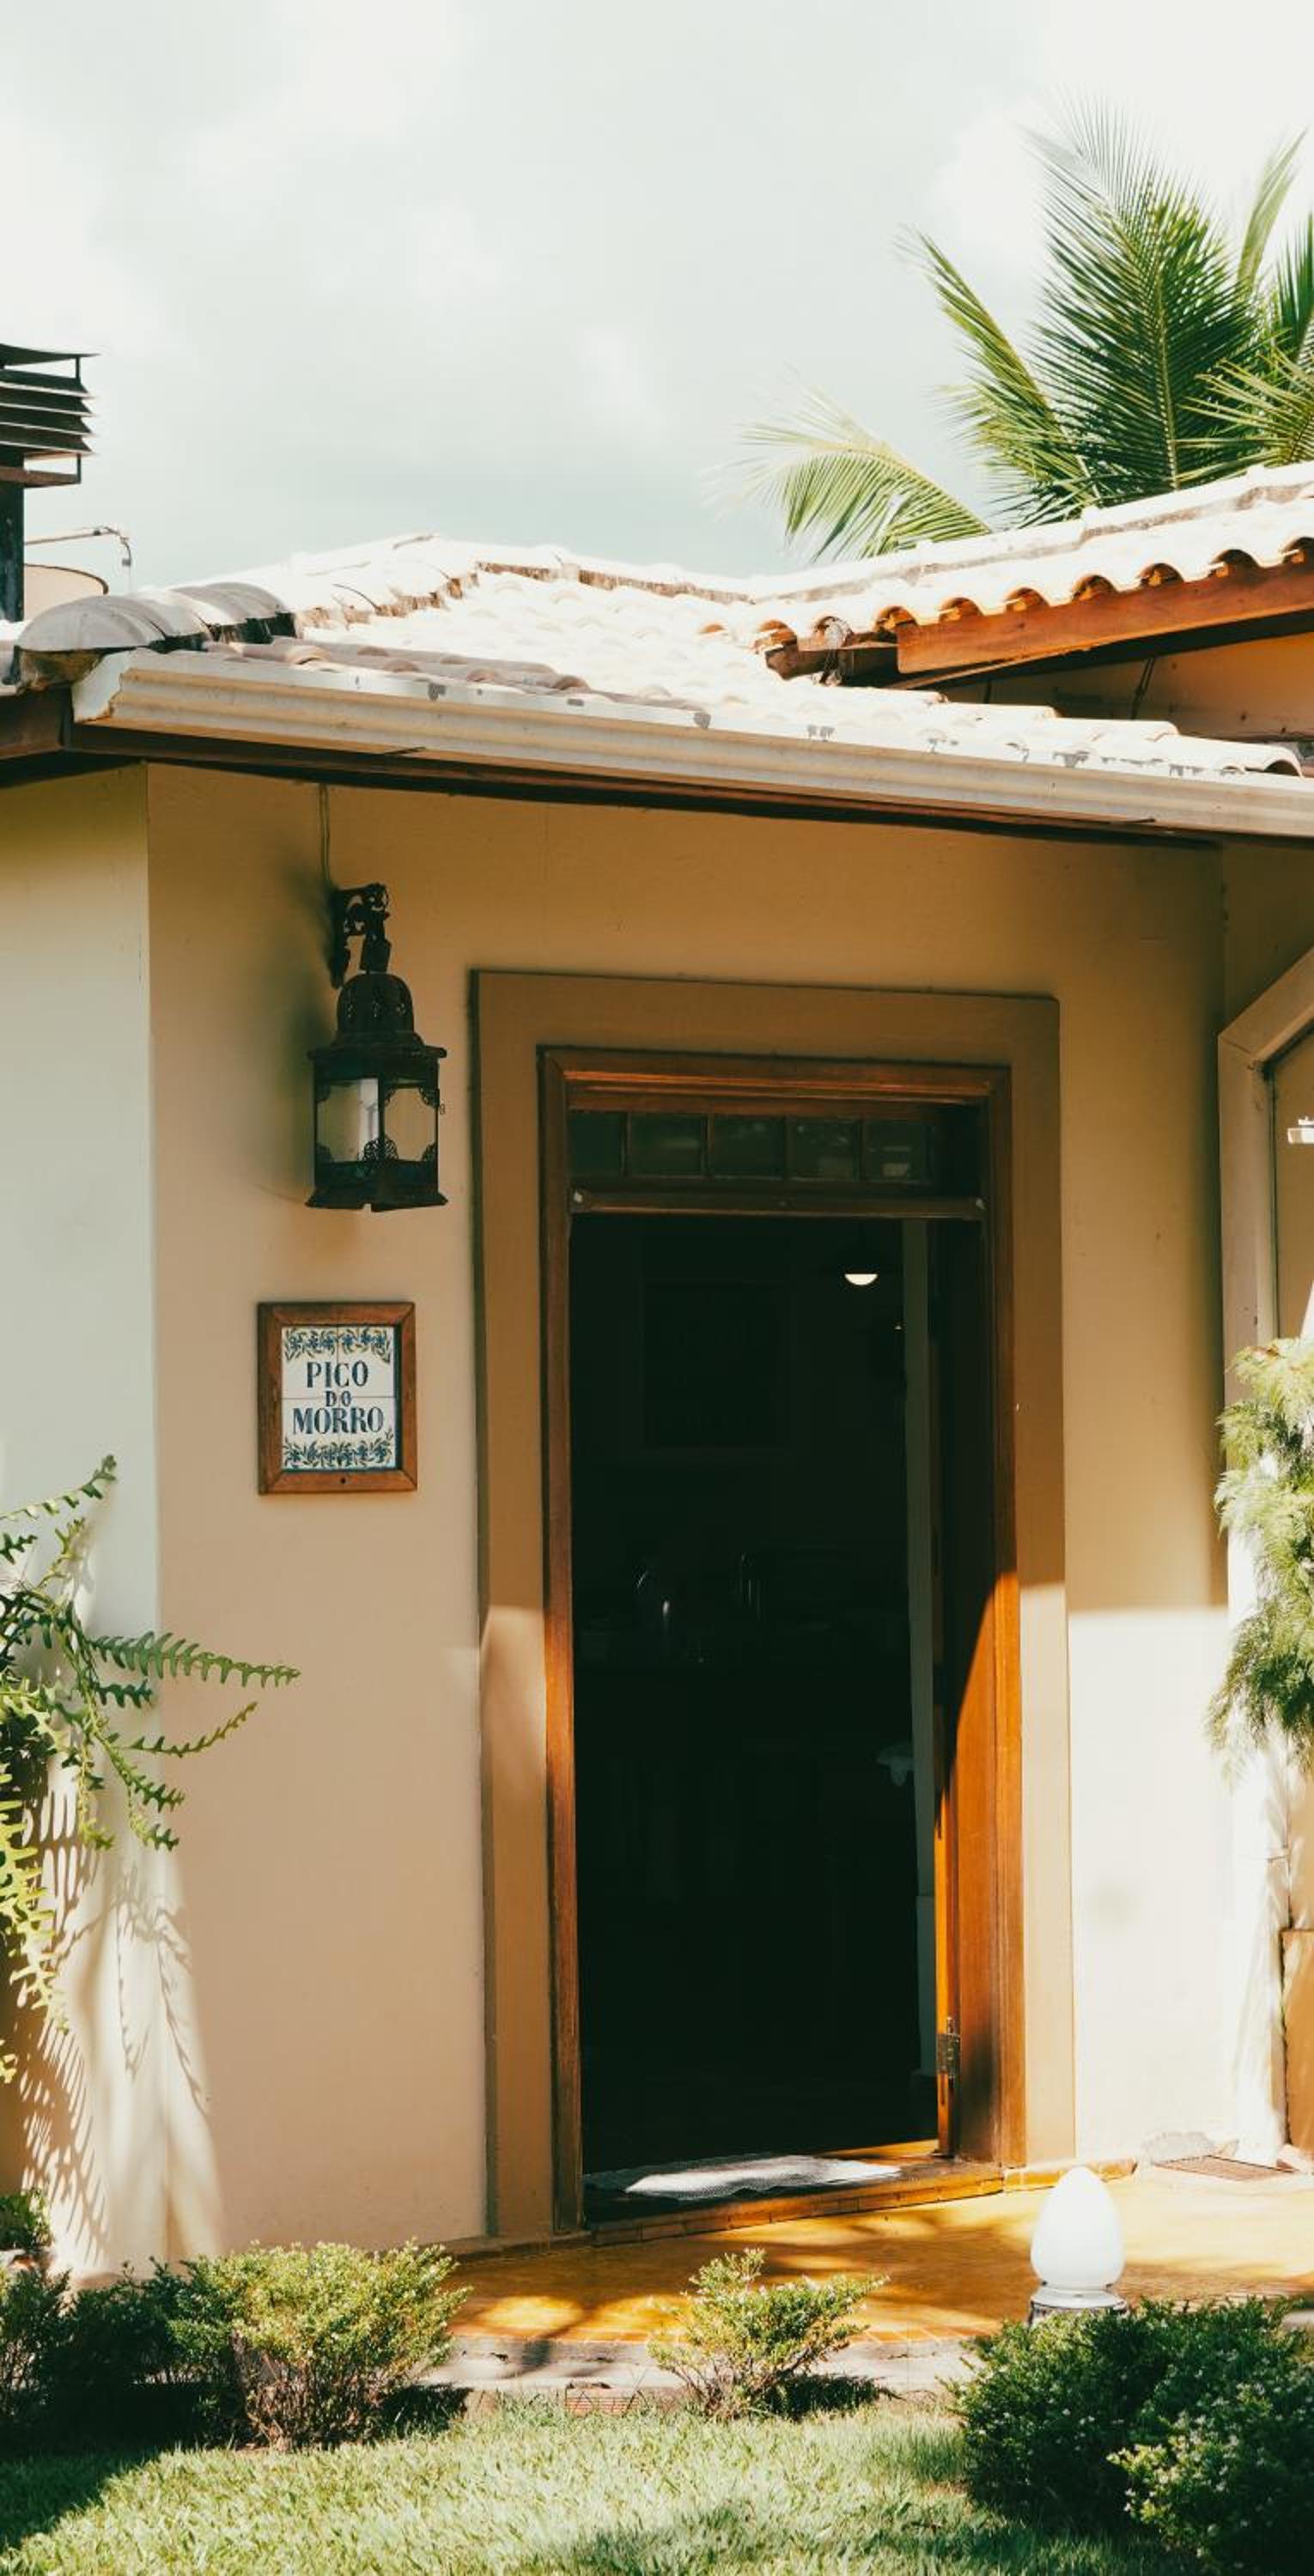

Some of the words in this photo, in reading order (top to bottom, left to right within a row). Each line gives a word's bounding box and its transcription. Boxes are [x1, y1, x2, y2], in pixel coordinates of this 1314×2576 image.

[307, 1360, 368, 1388] PICO
[325, 1390, 352, 1406] DO
[293, 1406, 384, 1434] MORRO
